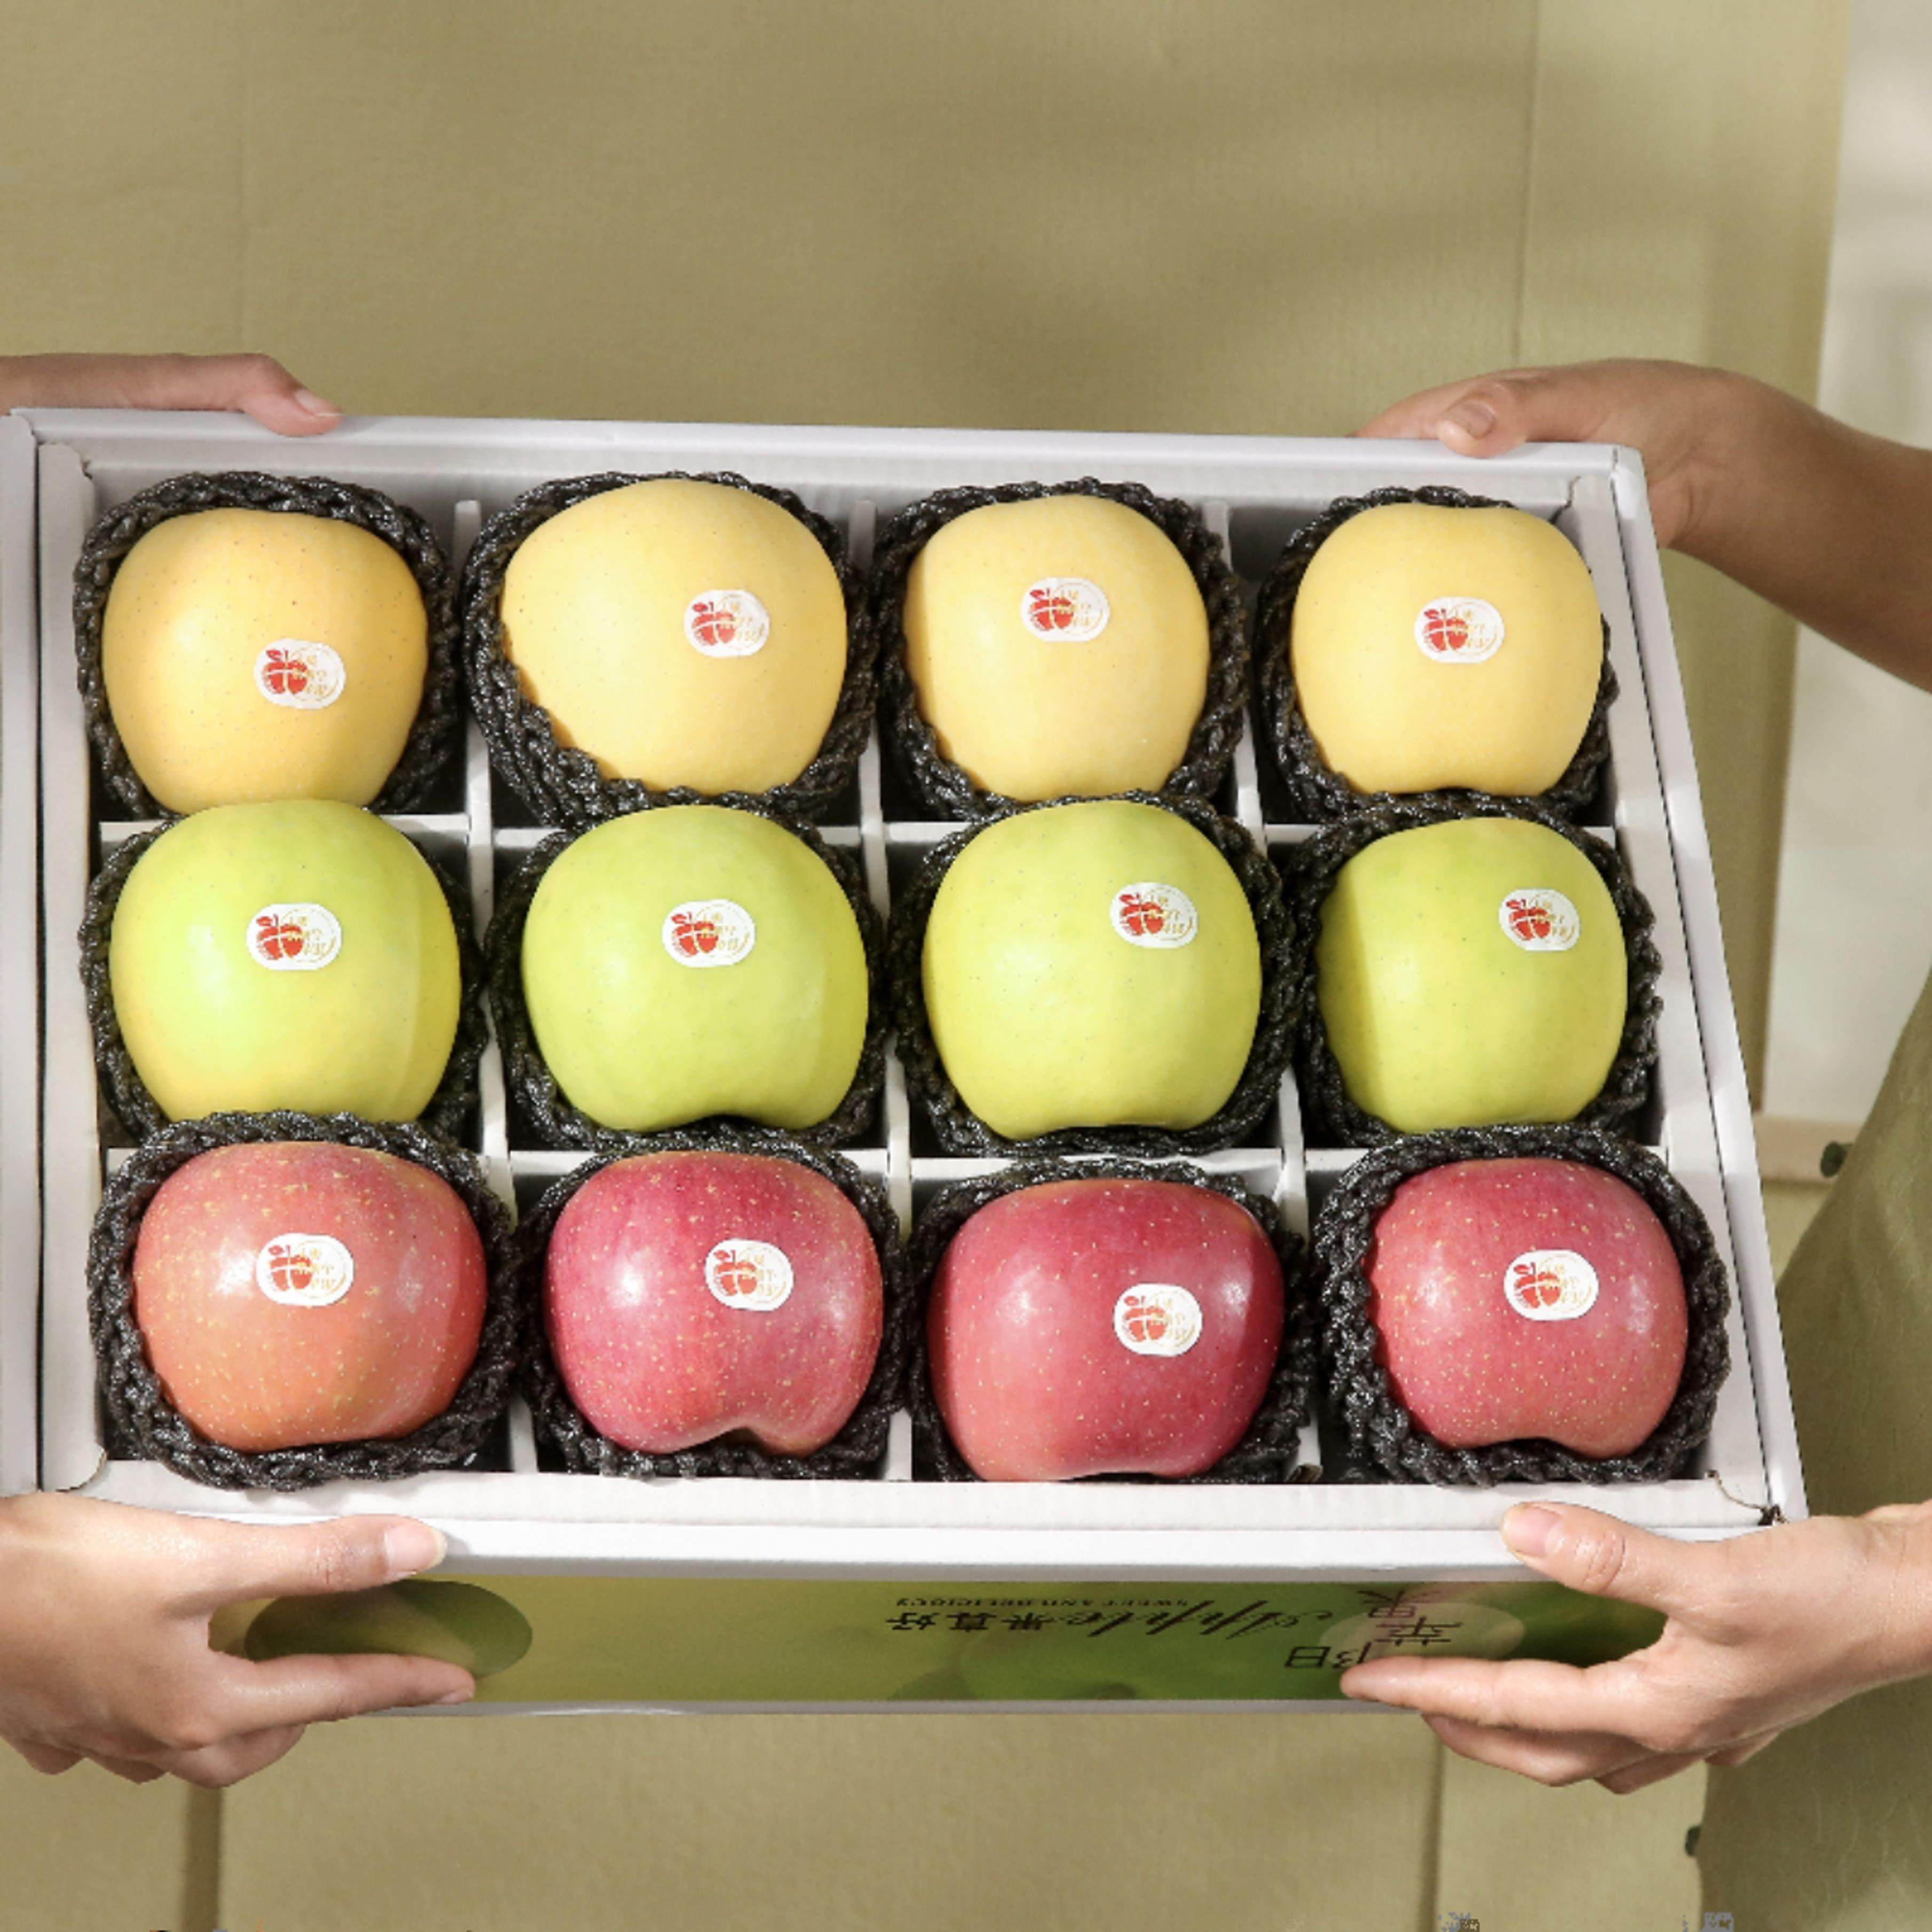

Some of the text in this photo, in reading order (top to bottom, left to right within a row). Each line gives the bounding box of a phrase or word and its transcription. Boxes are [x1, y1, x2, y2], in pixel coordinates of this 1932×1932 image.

[885, 1611, 1055, 1633] 果真好
[1060, 1600, 1334, 1640] Apple
